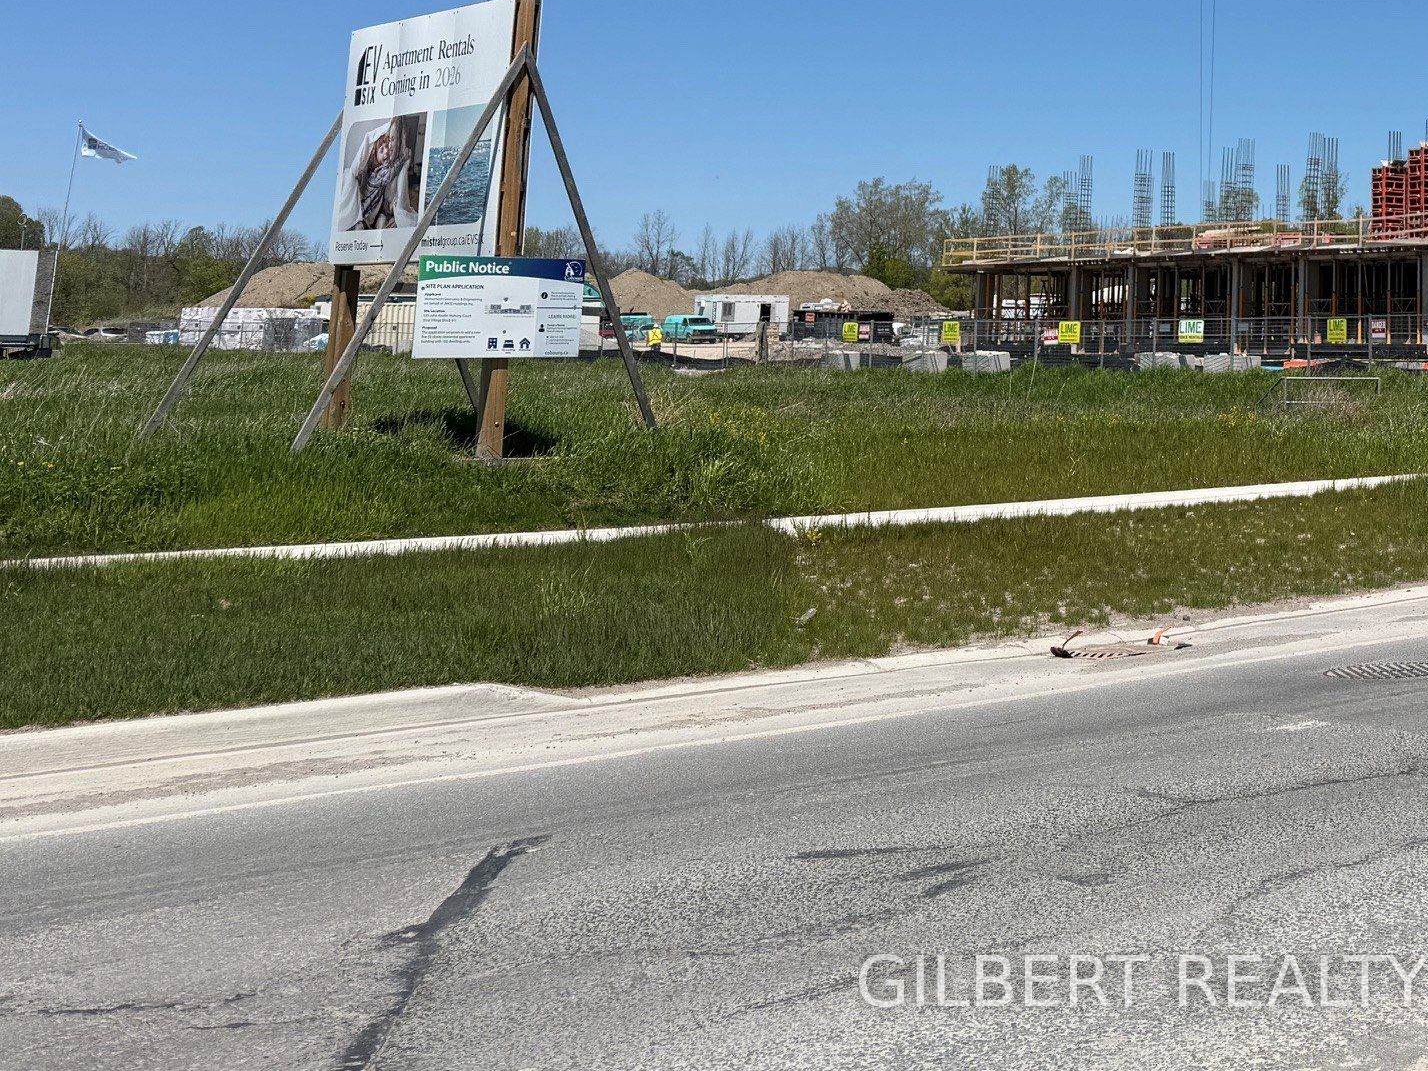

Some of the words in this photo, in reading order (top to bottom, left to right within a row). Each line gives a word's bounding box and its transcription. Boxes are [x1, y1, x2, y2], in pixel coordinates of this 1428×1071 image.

[383, 44, 434, 74] Apartment
[438, 33, 475, 60] Rentals
[380, 74, 417, 97] Coming
[419, 70, 430, 90] in
[435, 65, 461, 88] 2026
[361, 86, 376, 105] SIX
[354, 239, 369, 252] Today
[425, 260, 467, 274] Public
[468, 261, 510, 274] Notice
[943, 323, 958, 334] LIME
[1060, 322, 1078, 334] LIME
[1179, 321, 1203, 334] LIME
[1328, 319, 1345, 332] LIME
